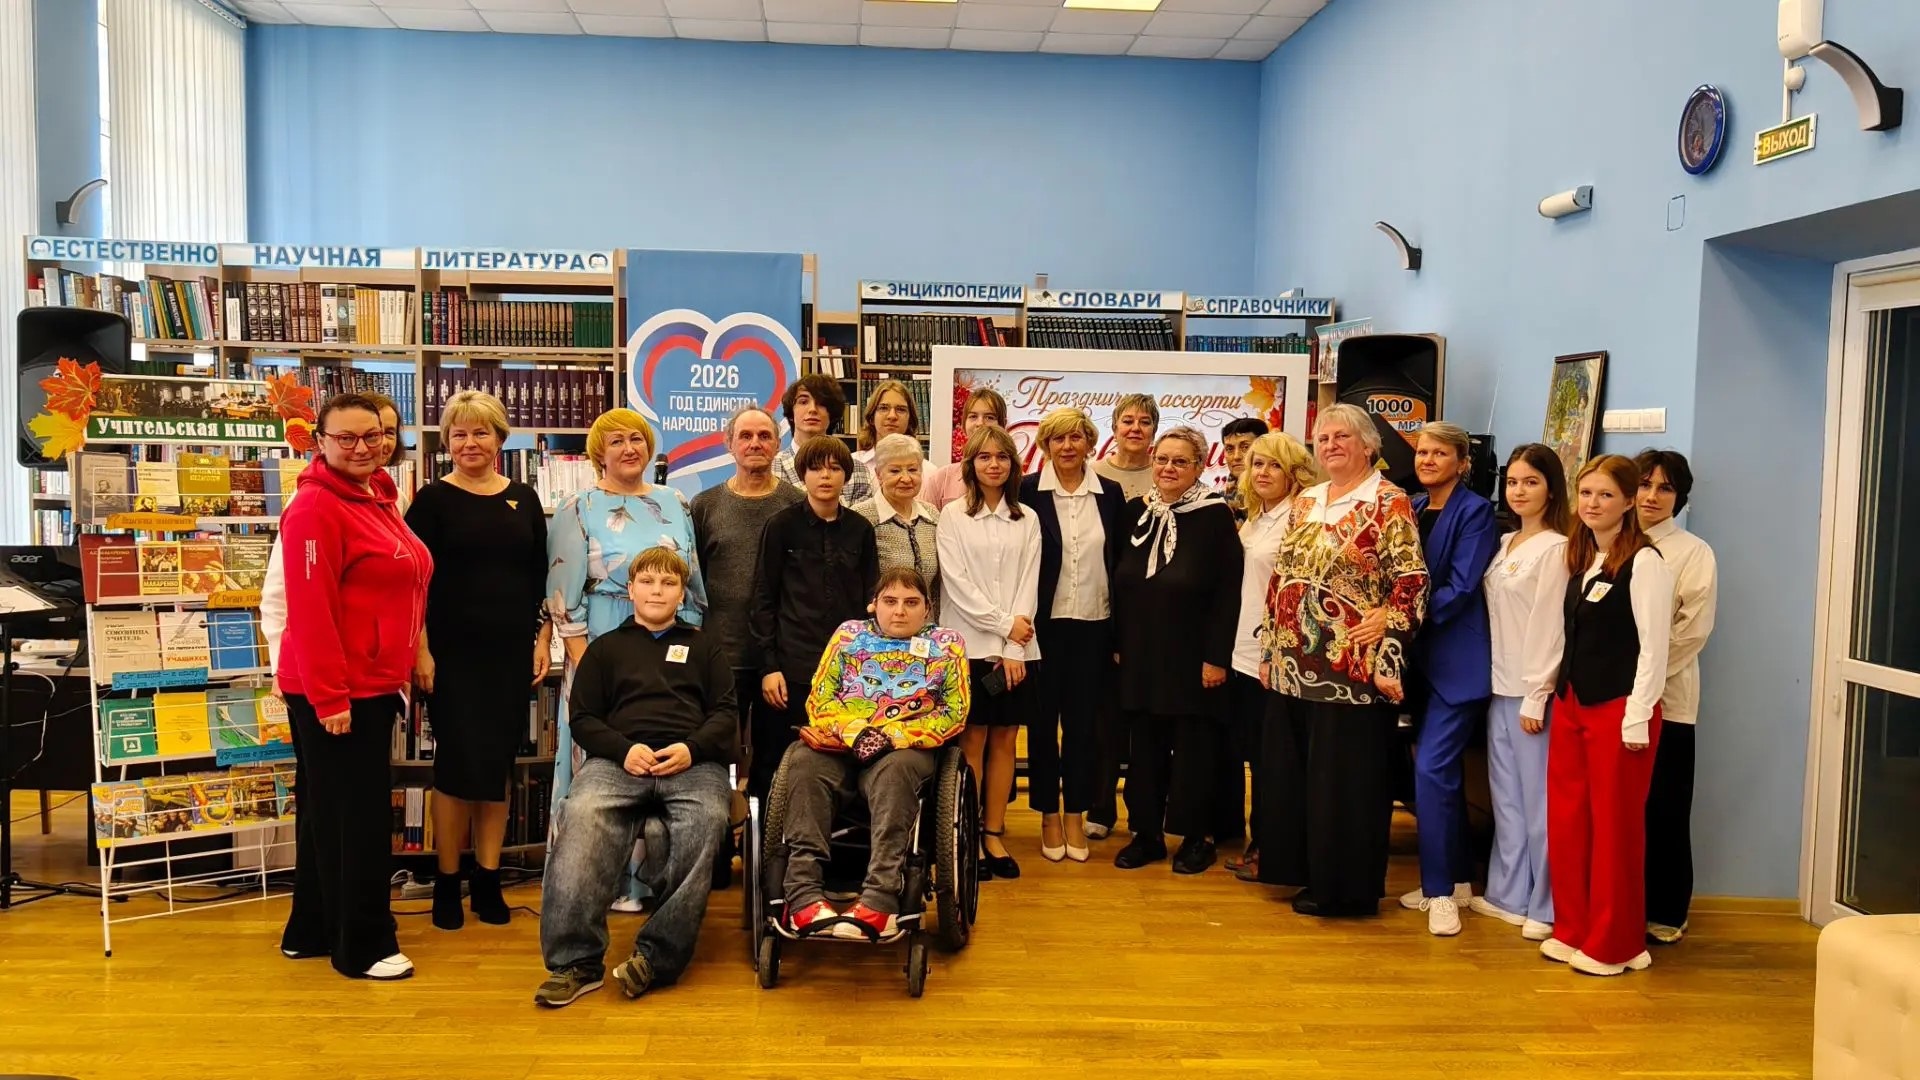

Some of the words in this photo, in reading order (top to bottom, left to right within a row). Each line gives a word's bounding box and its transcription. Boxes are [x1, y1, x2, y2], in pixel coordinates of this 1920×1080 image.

[1762, 125, 1806, 155] ВЫХОД
[53, 239, 218, 263] ЕСТЕСТВЕННО
[255, 245, 381, 267] НАУЧНАЯ
[425, 251, 585, 270] ЛИТЕРАТУРА
[887, 282, 1022, 301] ЭНЦИКЛОПЕДИИ
[1058, 291, 1161, 308] СЛОВАРИ
[1207, 298, 1329, 315] СПРАВОЧНИКИ
[690, 364, 739, 388] 2026
[669, 395, 694, 411] ГОД
[1012, 376, 1123, 415] Празднич
[1159, 391, 1243, 419] ассорти
[1366, 398, 1413, 414] 1000
[96, 417, 218, 437] Учительская
[225, 422, 276, 439] книга
[662, 416, 718, 433] НАРОДОВ
[10, 554, 43, 563] acer
